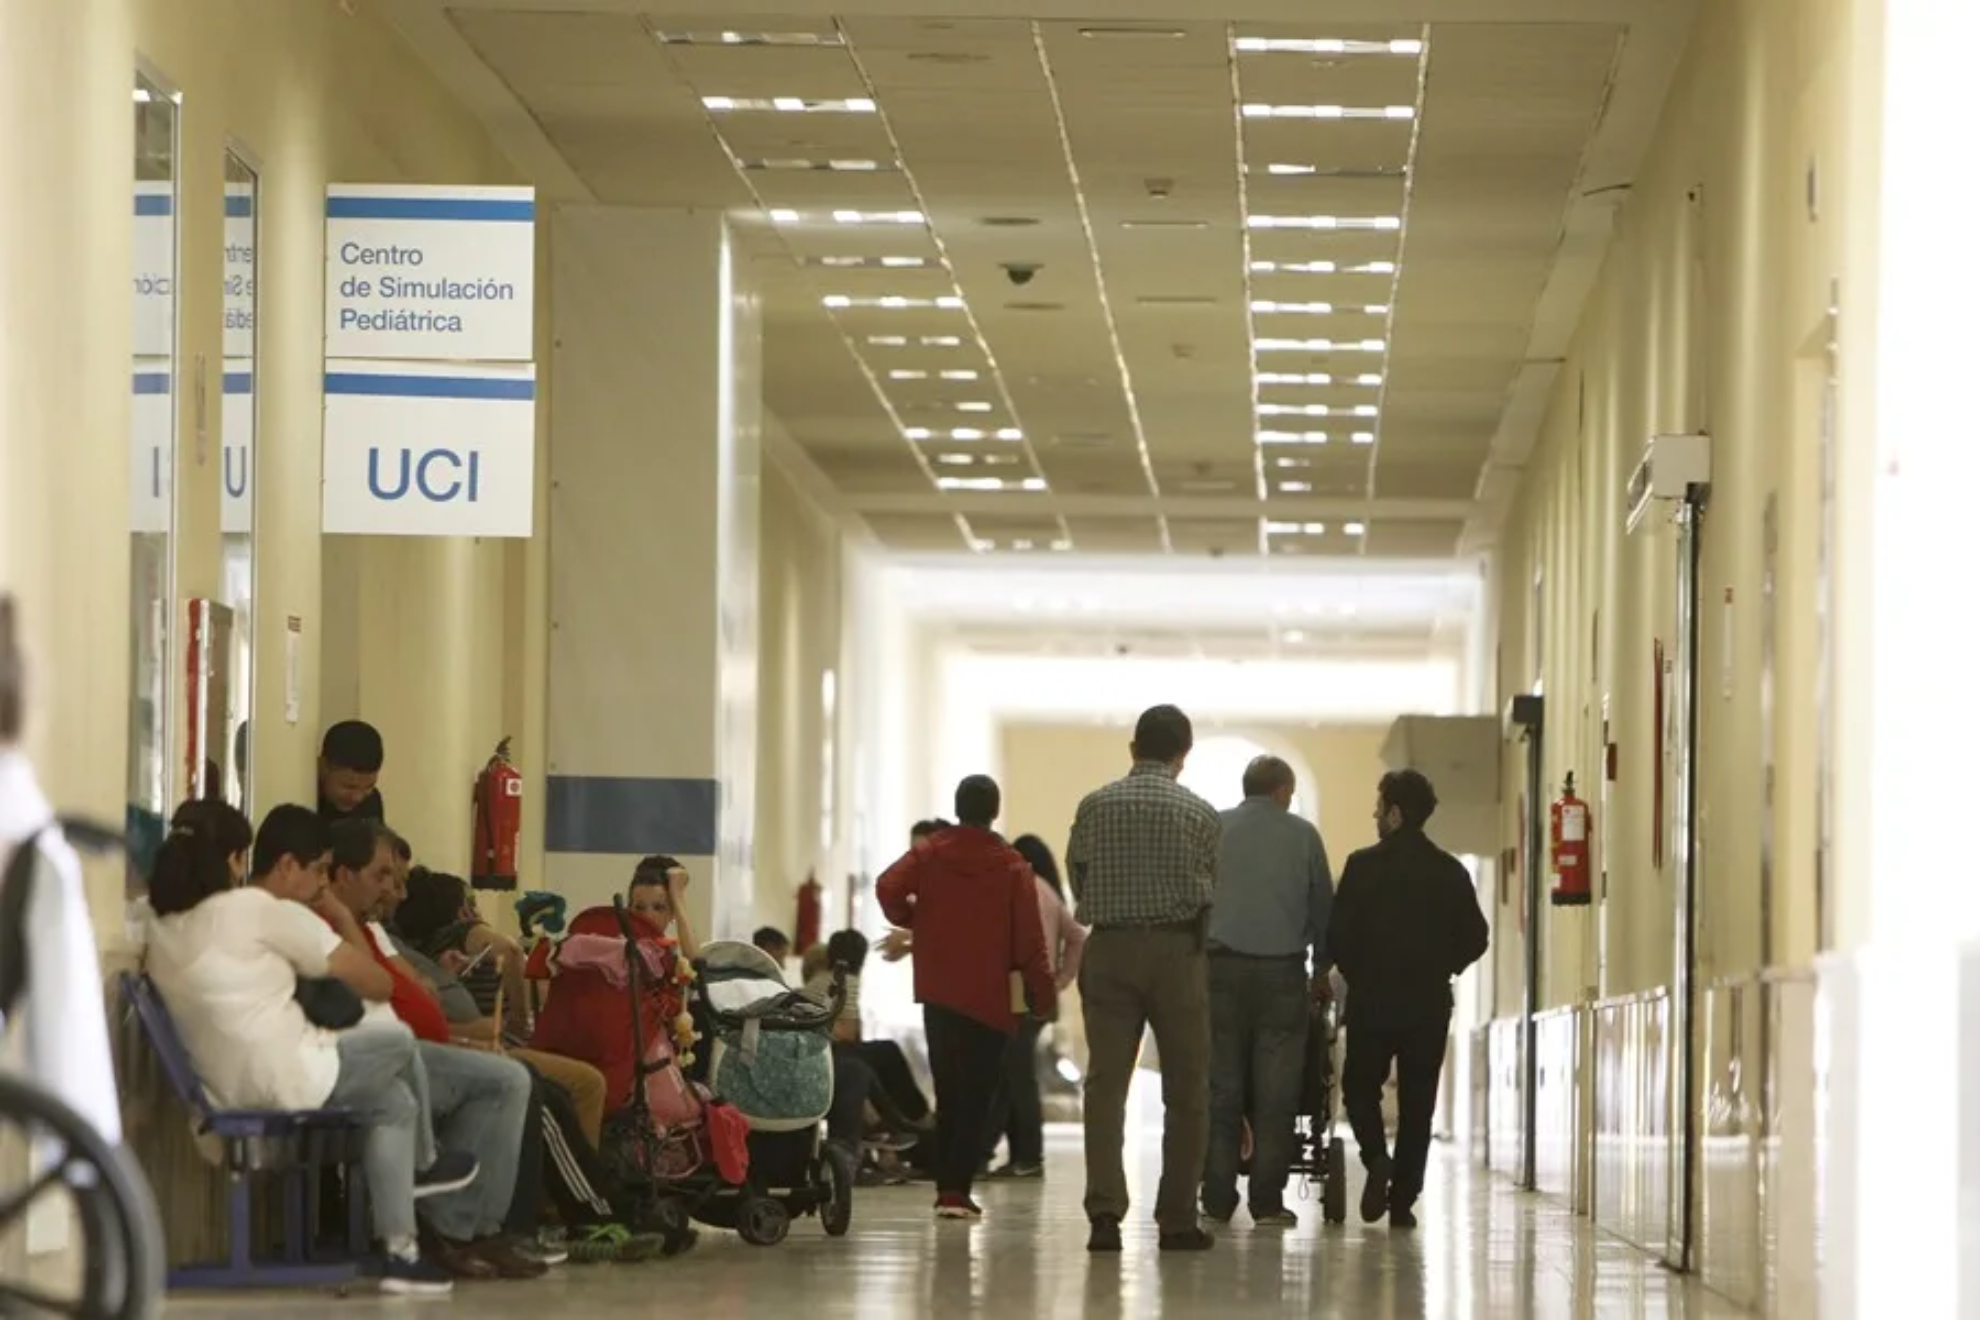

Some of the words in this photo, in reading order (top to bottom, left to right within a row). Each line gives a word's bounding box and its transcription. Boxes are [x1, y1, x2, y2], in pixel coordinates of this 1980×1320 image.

[340, 241, 424, 266] Centro
[339, 275, 371, 298] de
[378, 275, 514, 300] Simulación
[339, 307, 463, 333] Pediátrica
[367, 447, 479, 503] UCI
